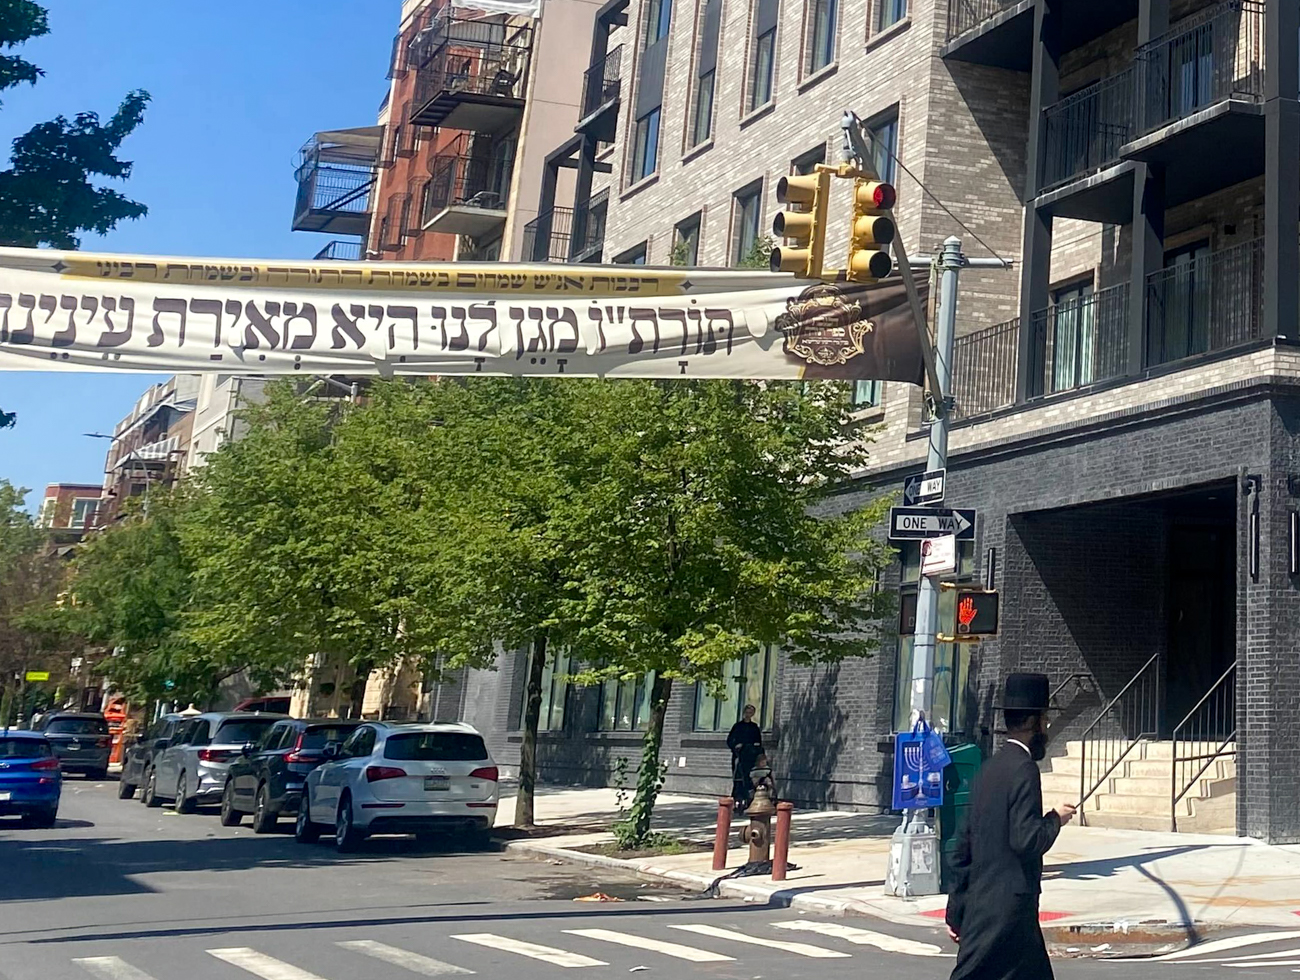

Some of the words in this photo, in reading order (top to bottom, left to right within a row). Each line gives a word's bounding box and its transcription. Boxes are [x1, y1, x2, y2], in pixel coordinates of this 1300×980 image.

[163, 263, 260, 282] ובשמחת
[266, 267, 363, 285] התורה
[368, 270, 450, 287] בשמחת
[456, 272, 527, 289] שמחים
[590, 276, 659, 292] רבבות
[908, 483, 921, 497] ONE
[927, 479, 941, 493] WAY
[903, 517, 927, 530] ONE
[938, 518, 963, 530] WAY
